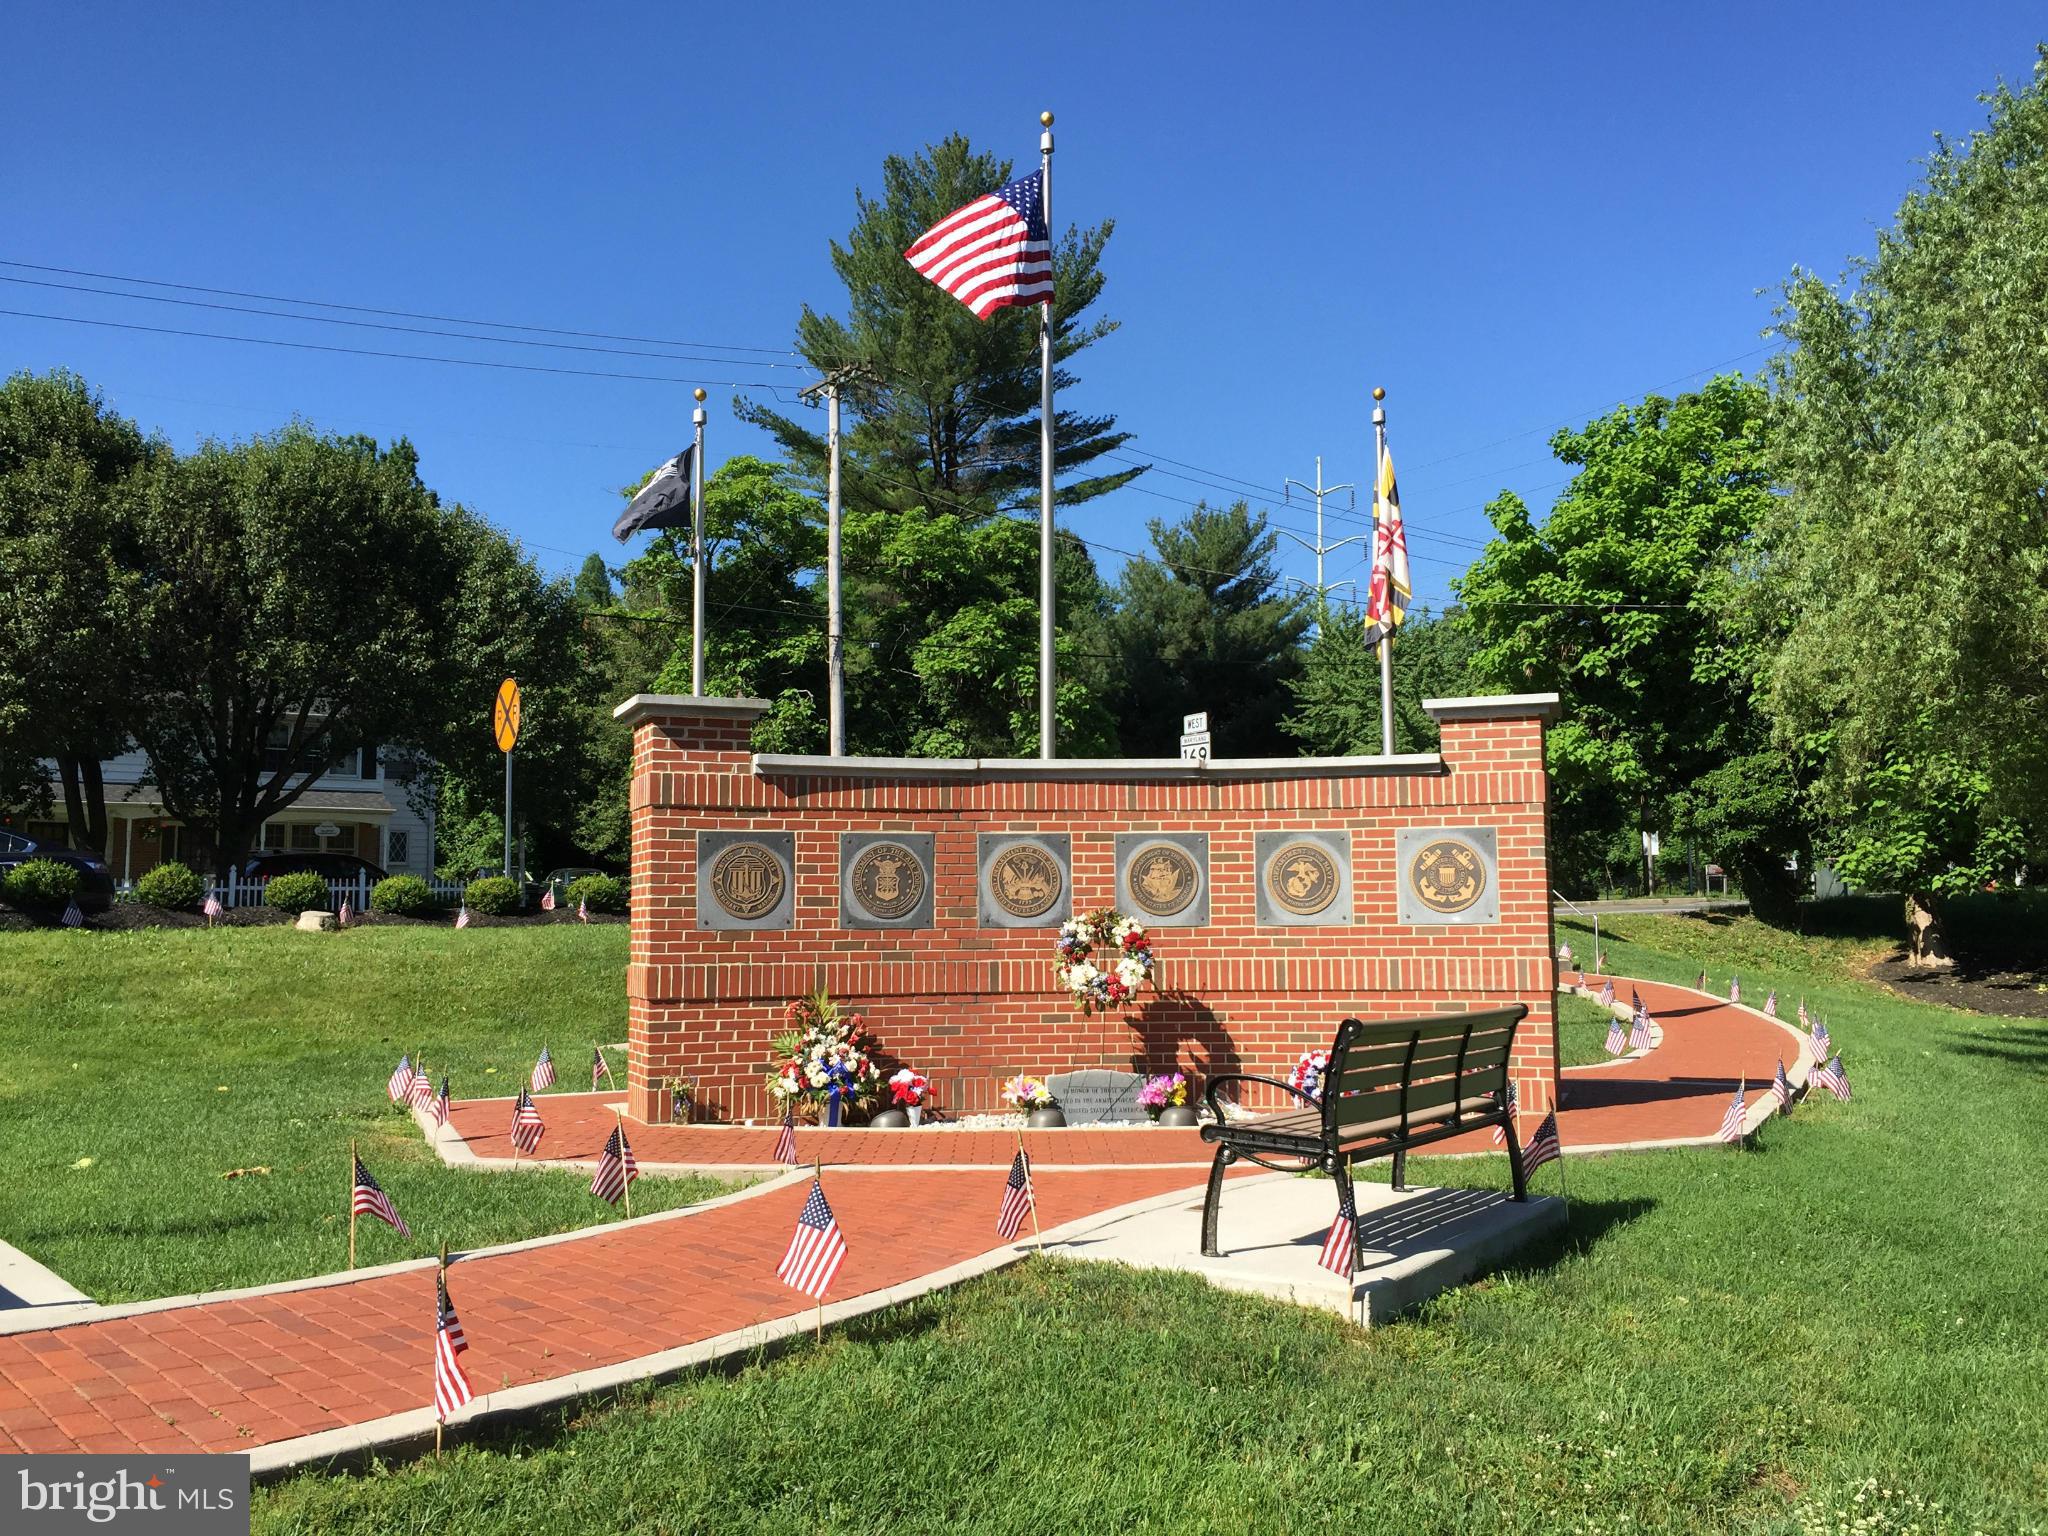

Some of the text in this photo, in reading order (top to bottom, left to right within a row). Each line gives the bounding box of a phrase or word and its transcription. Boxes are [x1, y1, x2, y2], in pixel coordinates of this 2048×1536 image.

[1188, 718, 1203, 729] WEST
[758, 851, 778, 872] STATES
[855, 852, 875, 895] DEPARTMENT
[890, 848, 905, 857] THE
[905, 856, 916, 870] AIR
[993, 848, 1024, 879] DEPARTMENT
[1323, 860, 1334, 880] NAVY
[716, 888, 740, 912] MERCHANT
